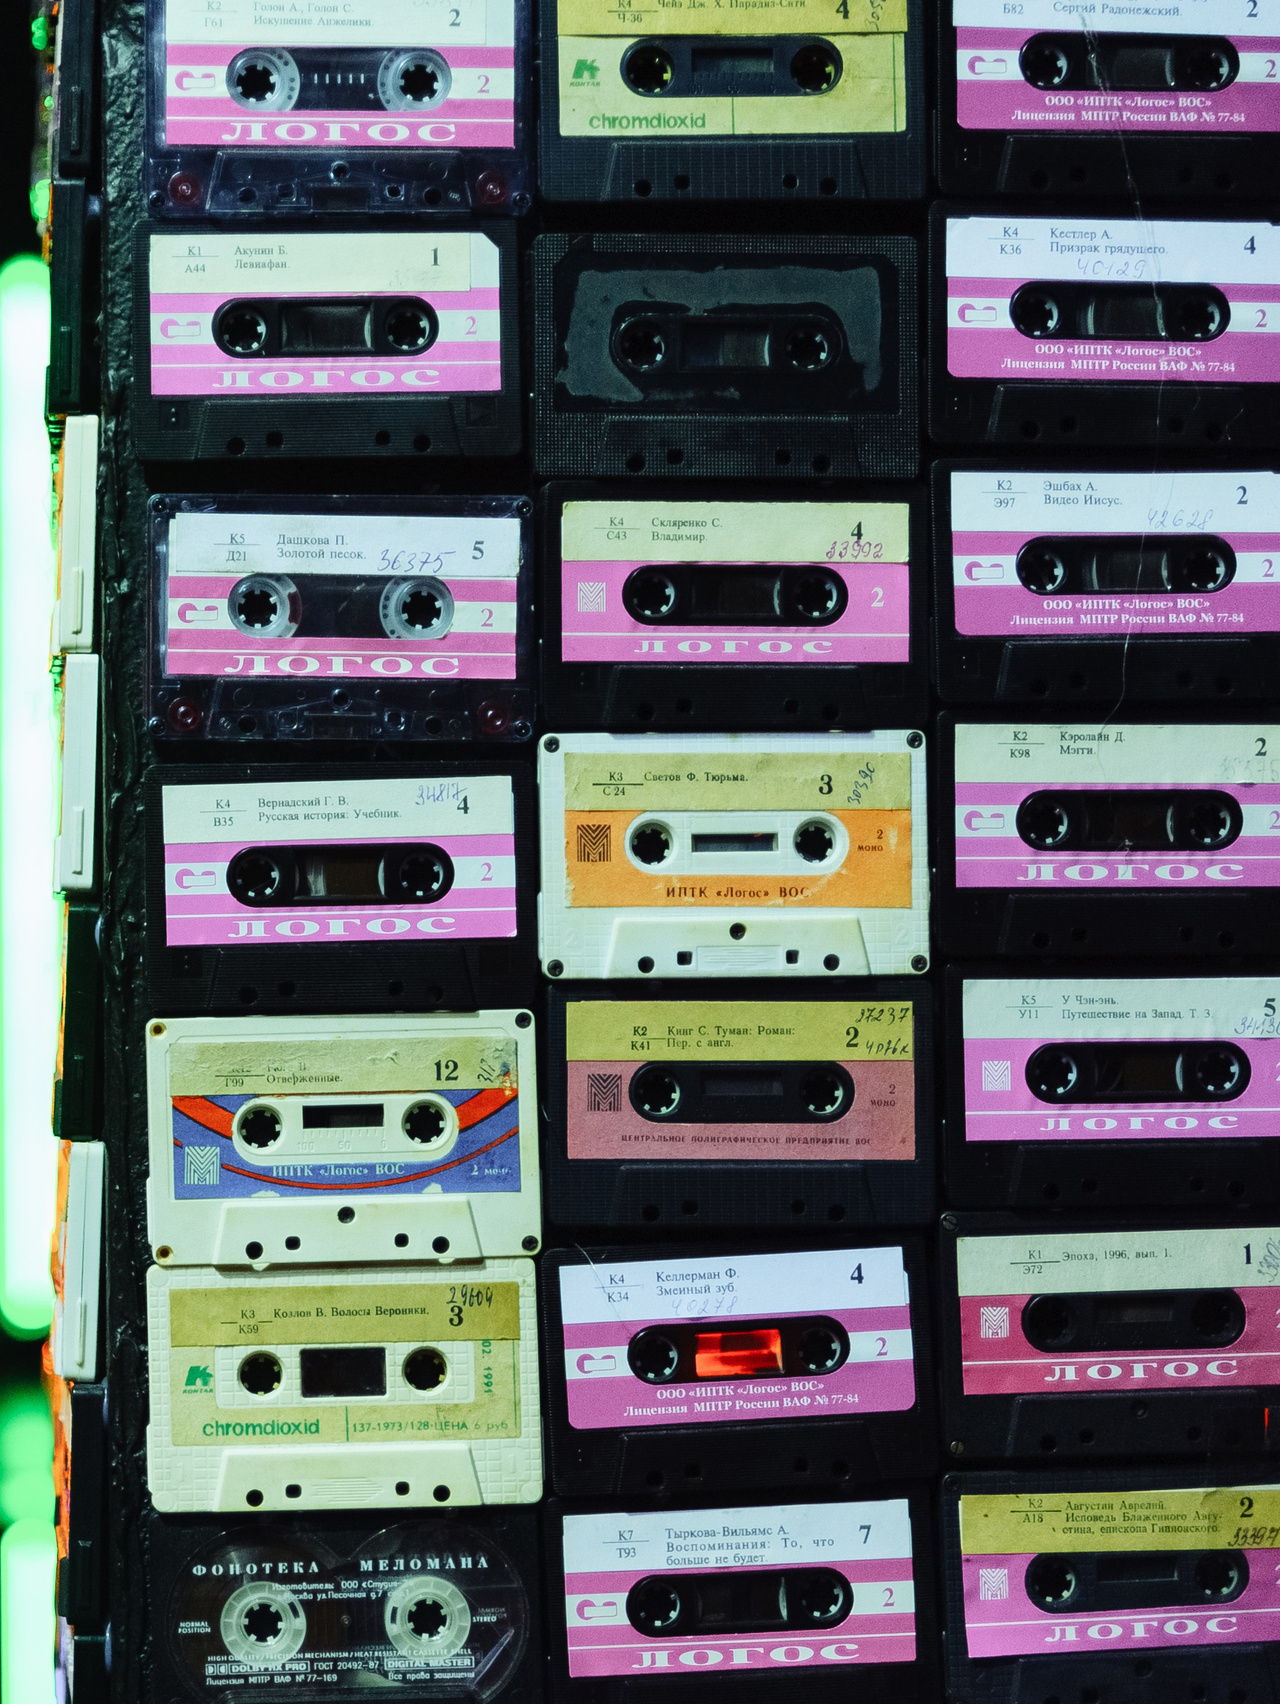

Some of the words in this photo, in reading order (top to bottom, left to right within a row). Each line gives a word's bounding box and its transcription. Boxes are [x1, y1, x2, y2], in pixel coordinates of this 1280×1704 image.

[1003, 3, 1024, 15] Б82
[1053, 2, 1096, 14] Сергий
[1101, 4, 1183, 17] Радонежский.
[1246, 0, 1258, 18] 2
[253, 15, 312, 27] Искушение
[317, 15, 374, 27] Анжелики.
[448, 9, 462, 27] 2
[1264, 59, 1277, 78] 2
[476, 74, 490, 94] 2
[588, 112, 706, 130] chromdioxid
[221, 122, 457, 142] ЛОГОС
[1002, 227, 1019, 238] К4
[1049, 227, 1097, 241] Кестлер
[234, 245, 275, 256] Акунин
[999, 244, 1022, 256] К36
[1049, 242, 1101, 254] Призрак
[1104, 244, 1168, 256] грядущего.
[1243, 235, 1256, 255] 4
[430, 247, 441, 267] 1
[184, 264, 206, 274] А44
[234, 259, 290, 271] Левиафан.
[464, 316, 478, 335] 2
[1254, 309, 1268, 328] 2
[212, 369, 441, 388] ЛОГОС
[997, 480, 1013, 491] К2
[1043, 480, 1082, 492] Эшбах
[1043, 494, 1079, 506] Видео
[1083, 494, 1122, 506] Иисус.
[1236, 485, 1249, 505] 2
[993, 497, 1016, 509] Э97
[609, 517, 625, 527] К4
[651, 517, 708, 529] Скляренко
[606, 530, 627, 541] С43
[651, 531, 708, 543] Владимир.
[850, 521, 864, 541] 4
[229, 534, 246, 545] К5
[276, 534, 331, 547] Дашкова
[225, 550, 247, 563] Д21
[276, 547, 325, 559] Золотой
[329, 549, 366, 560] песок.
[472, 540, 485, 560] 5
[377, 548, 456, 573] 36375
[1261, 559, 1274, 578] 2
[870, 587, 884, 608] 2
[1043, 599, 1073, 610] ООО
[1075, 599, 1121, 610] «ИПТК
[1123, 598, 1174, 610] «Логос»
[1176, 598, 1210, 609] ВОС»
[480, 608, 494, 628] 2
[1010, 614, 1074, 626] Лицензия
[1079, 613, 1118, 624] МПТР
[1121, 613, 1165, 624] России
[1168, 613, 1196, 624] ВАФ
[1198, 612, 1214, 624] №
[1216, 612, 1244, 623] 77-84
[634, 640, 833, 654] ЛОГОС
[224, 655, 459, 675] ЛОГОС
[1013, 731, 1028, 741] К2
[1059, 731, 1109, 743] Кэролайн
[1009, 748, 1031, 759] К98
[1059, 744, 1097, 757] Мэгги.
[1254, 737, 1268, 757] 2
[643, 771, 682, 783] Светов
[704, 771, 749, 784] Тюрьма.
[818, 774, 833, 795] 3
[215, 798, 231, 809] К4
[257, 796, 320, 809] Вернадский
[456, 794, 470, 815] 4
[213, 815, 234, 827] В35
[258, 810, 300, 823] Русская
[303, 810, 350, 822] история:
[353, 807, 402, 820] Учебник.
[480, 862, 494, 882] 2
[1016, 864, 1244, 881] ЛОГОС
[666, 886, 709, 898] ИПТК
[716, 887, 770, 899] «Логос»
[779, 886, 810, 898] ВОС
[228, 916, 456, 938] ЛОГОС
[1021, 995, 1037, 1005] К5
[1062, 995, 1070, 1006] У
[1075, 995, 1119, 1006] Чэн-энь.
[1018, 1009, 1039, 1020] У11
[1061, 1008, 1131, 1021] Путешествие
[1151, 1009, 1185, 1021] Запад.
[1263, 998, 1277, 1017] 5
[633, 1026, 648, 1037] К2
[667, 1026, 694, 1038] Кинг
[715, 1026, 753, 1038] Туман:
[757, 1026, 795, 1038] Роман:
[845, 1026, 859, 1048] 2
[630, 1040, 651, 1052] К41
[667, 1038, 691, 1049] Пер.
[707, 1039, 734, 1050] англ.
[434, 1059, 459, 1082] 12
[266, 1073, 343, 1086] Отверженные.
[1039, 1116, 1239, 1131] ЛОГОС
[272, 1165, 313, 1177] ИПТК
[319, 1164, 368, 1177] «Логос»
[375, 1163, 405, 1175] ВОС
[1062, 1250, 1098, 1263] Эпоха,
[1103, 1250, 1130, 1261] 1996,
[1243, 1243, 1252, 1265] 1
[849, 1262, 865, 1285] 4
[1022, 1263, 1043, 1275] Э72
[608, 1273, 625, 1285] К4
[655, 1271, 721, 1283] Келлерман
[656, 1283, 712, 1296] Змеиный
[715, 1283, 738, 1295] зуб.
[607, 1291, 629, 1303] К34
[240, 1308, 256, 1319] К3
[273, 1306, 312, 1320] Козлов
[331, 1306, 371, 1318] Волосы
[375, 1305, 429, 1317] Вероники.
[448, 1304, 464, 1327] 3
[238, 1323, 260, 1335] К59
[874, 1337, 888, 1357] 2
[1044, 1359, 1238, 1382] ЛОГОС
[656, 1388, 686, 1400] ООО
[688, 1385, 735, 1398] «ИПТК
[737, 1383, 788, 1396] «Логос»
[790, 1380, 824, 1392] ВОС»
[202, 1419, 320, 1437] chromdioxid
[1065, 1501, 1114, 1512] Августин
[1119, 1500, 1167, 1511] Аврелий.
[1239, 1496, 1254, 1518] 2
[1023, 1513, 1044, 1523] А18
[1065, 1512, 1117, 1524] Исповедь
[1121, 1511, 1187, 1522] Блаженного
[1193, 1511, 1222, 1522] Авгу-
[618, 1529, 634, 1541] К7
[665, 1525, 773, 1539] Тыркова-Вильямс
[858, 1524, 872, 1544] 7
[666, 1538, 771, 1553] Воспоминания:
[781, 1537, 803, 1549] То,
[812, 1537, 835, 1548] что
[616, 1547, 636, 1558] Т93
[665, 1553, 711, 1566] больше
[733, 1552, 769, 1564] будет.
[191, 1561, 320, 1576] ФОНОТЕКА
[359, 1556, 489, 1572] МЕЛОМАНА
[882, 1587, 895, 1608] 2
[1044, 1616, 1238, 1642] ЛОГОС
[387, 1660, 425, 1669] DIGITAL
[429, 1657, 472, 1668] MASTER
[631, 1643, 859, 1669] ЛОГОС
